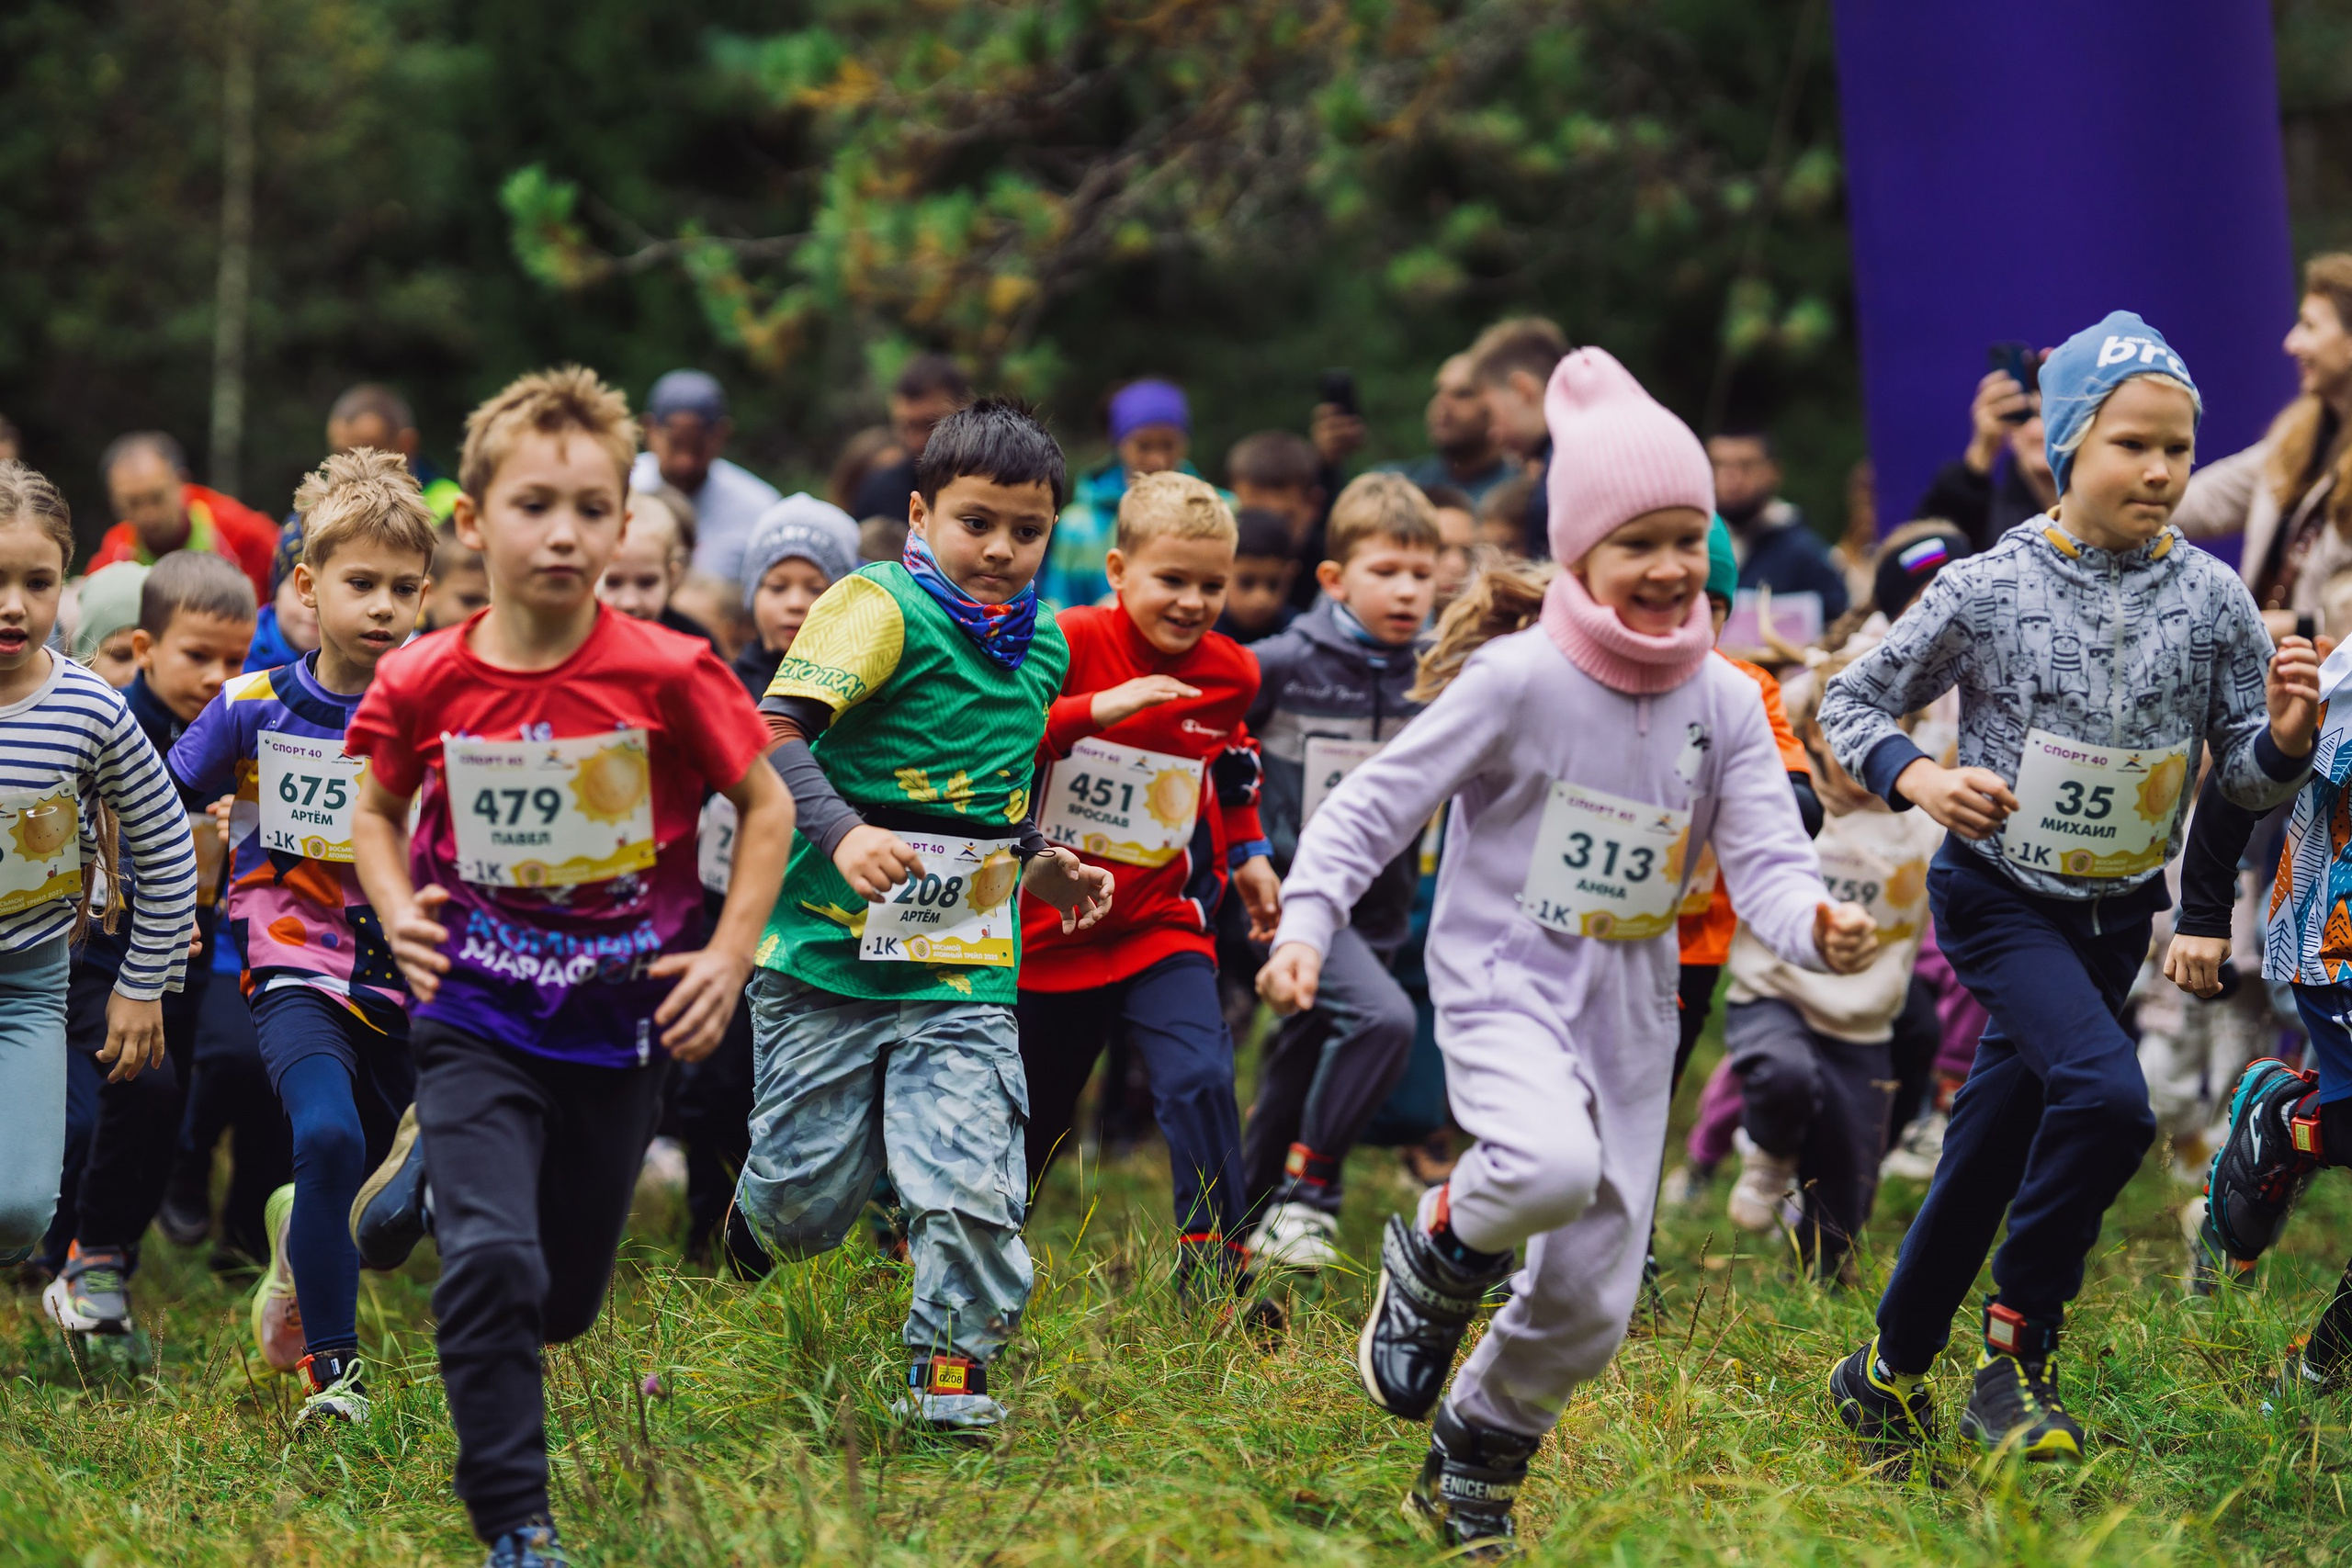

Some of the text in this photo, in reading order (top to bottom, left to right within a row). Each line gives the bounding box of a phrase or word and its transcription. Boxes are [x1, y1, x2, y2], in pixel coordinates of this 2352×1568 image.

[272, 743, 306, 758] СПОРТ
[308, 749, 322, 759] 40
[2043, 743, 2089, 762] СПОРТ
[2091, 755, 2109, 766] 40
[279, 772, 347, 810] 675
[1069, 772, 1135, 813] 451
[2054, 780, 2115, 819] 35
[473, 787, 561, 825] 479
[290, 809, 334, 825] АРТЁМ
[1068, 803, 1130, 828] ЯРОСЛАВ
[2040, 817, 2118, 840] МИХАИЛ
[491, 831, 551, 846] ПАВЕЛ
[328, 845, 356, 853] ВОСЬМО
[328, 852, 356, 860] АТОМНЫ
[931, 844, 944, 854] 40
[1563, 831, 1656, 883] 313
[27, 894, 47, 906] ТРЕЙЛ
[48, 888, 63, 898] 2025
[892, 870, 964, 908] 208
[1576, 877, 1627, 900] АННА
[899, 908, 942, 924] АРТЁМ
[932, 943, 962, 953] ВОСЬМОЙ
[963, 952, 983, 960] ТРЕЙЛ
[939, 1373, 963, 1384] 0208
